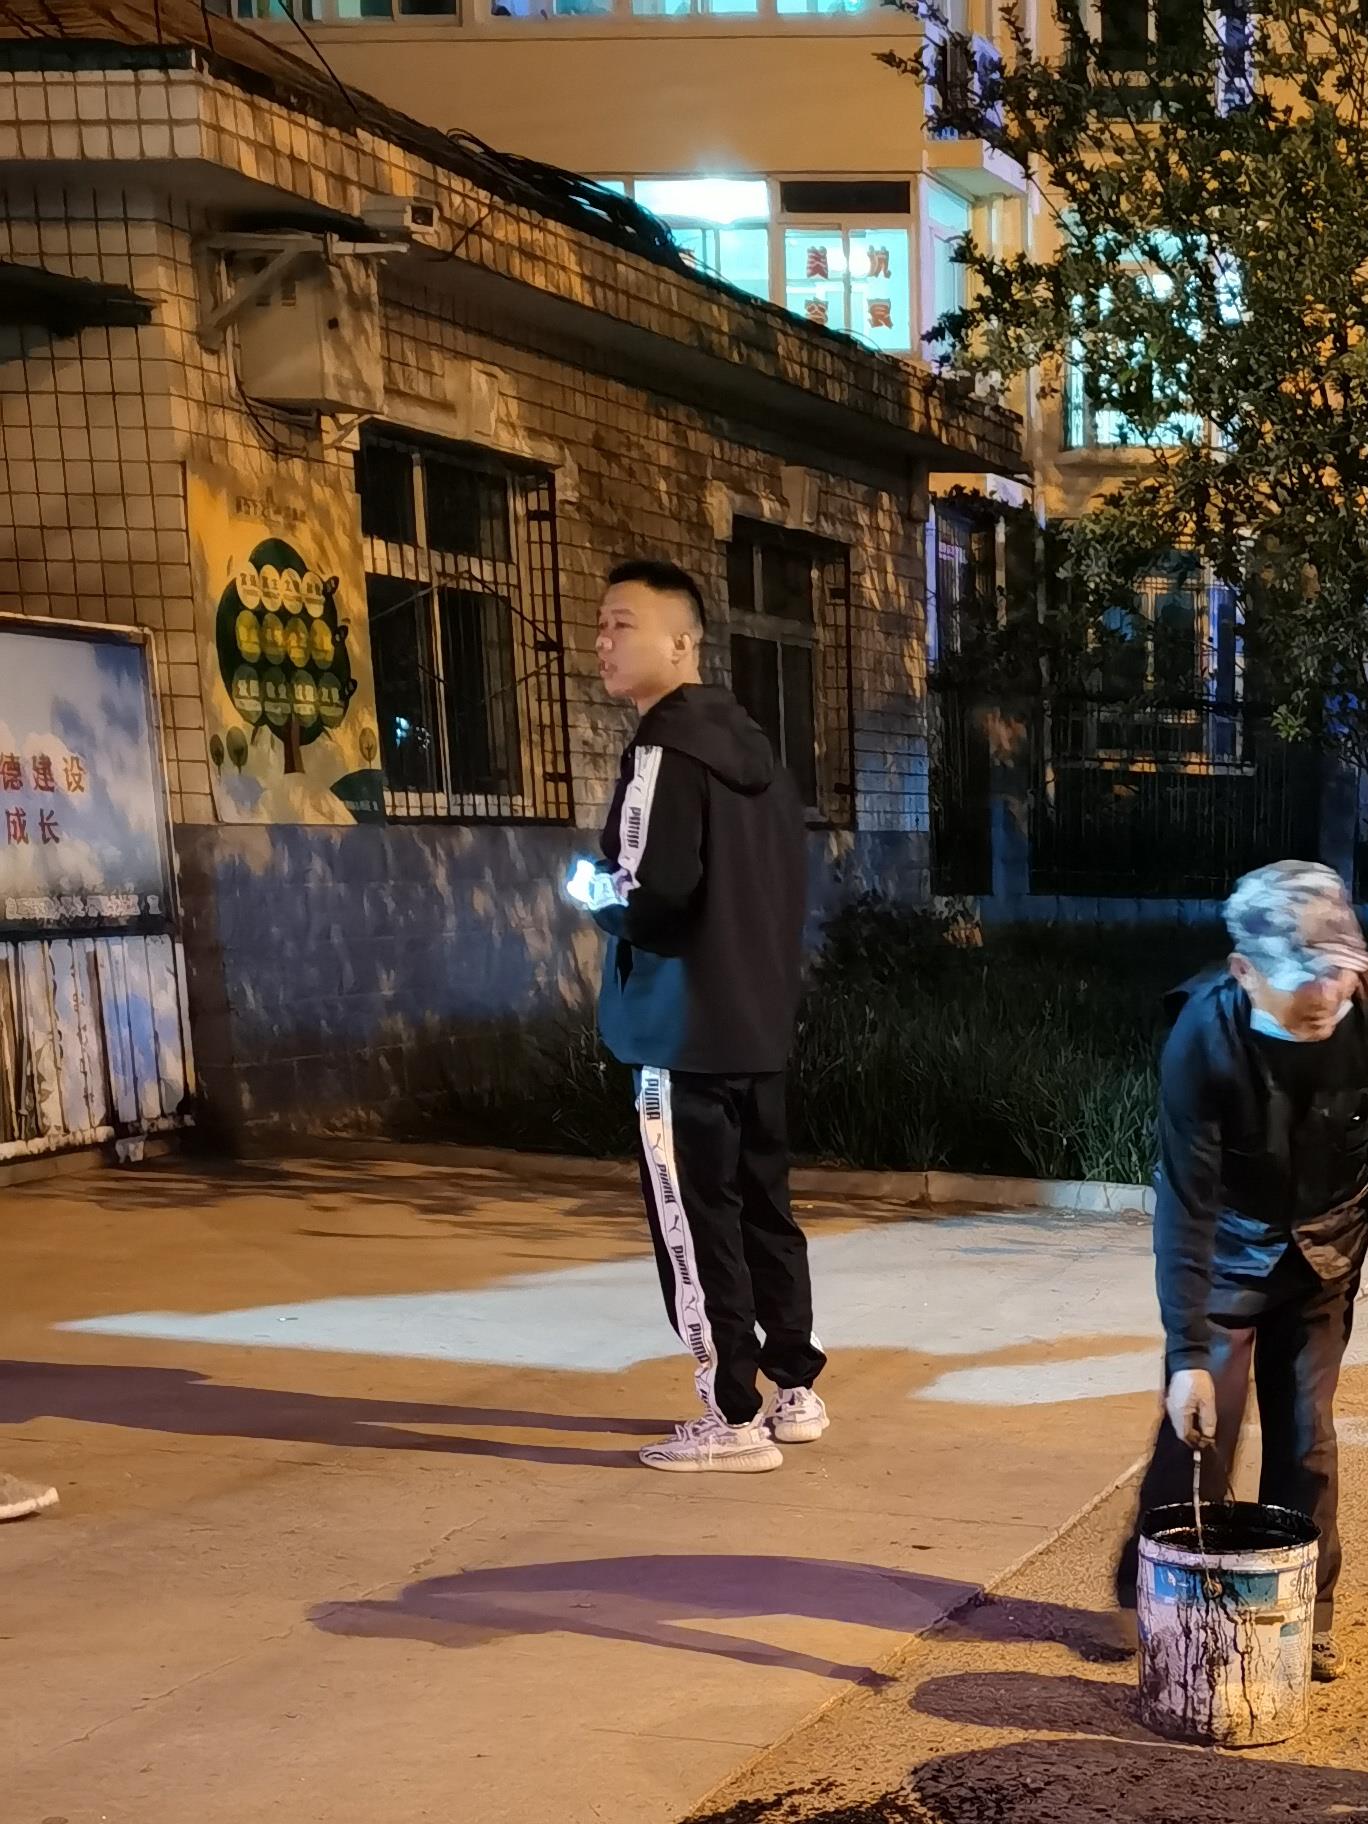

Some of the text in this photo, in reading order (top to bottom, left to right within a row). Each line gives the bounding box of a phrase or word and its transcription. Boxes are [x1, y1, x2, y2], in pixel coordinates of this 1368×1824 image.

[0, 752, 85, 793] 德建设
[5, 806, 60, 845] 成长
[645, 1078, 661, 1121] PUMA
